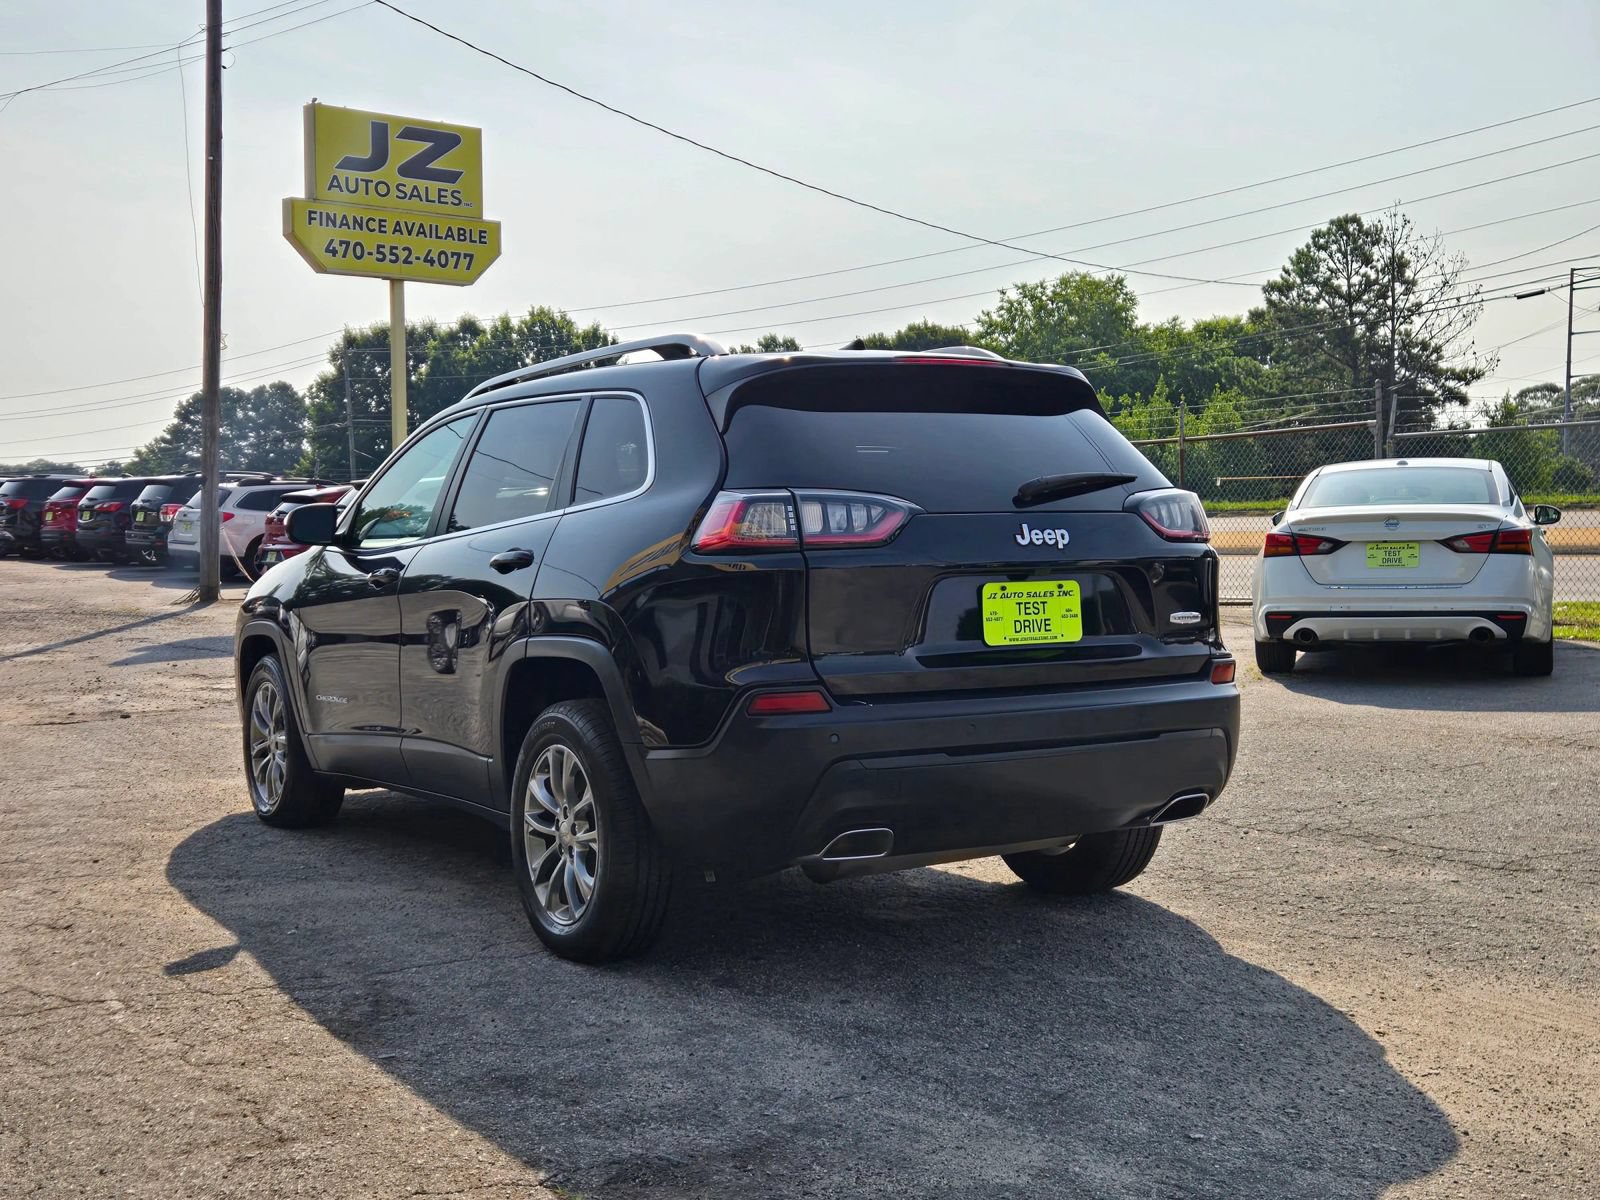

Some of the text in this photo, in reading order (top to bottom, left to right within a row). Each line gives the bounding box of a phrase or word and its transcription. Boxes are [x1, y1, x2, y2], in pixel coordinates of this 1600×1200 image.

[334, 120, 464, 184] JZ
[327, 174, 391, 198] AUTO
[395, 182, 463, 207] SALES
[307, 209, 488, 245] FINANCE AVAILABLE
[324, 238, 475, 271] 470-552-4077
[1015, 523, 1069, 549] Jeep
[1000, 591, 1024, 599] AUTO
[1026, 590, 1055, 598] SALES
[1015, 601, 1048, 616] TEST
[1013, 618, 1052, 633] DRIVE
